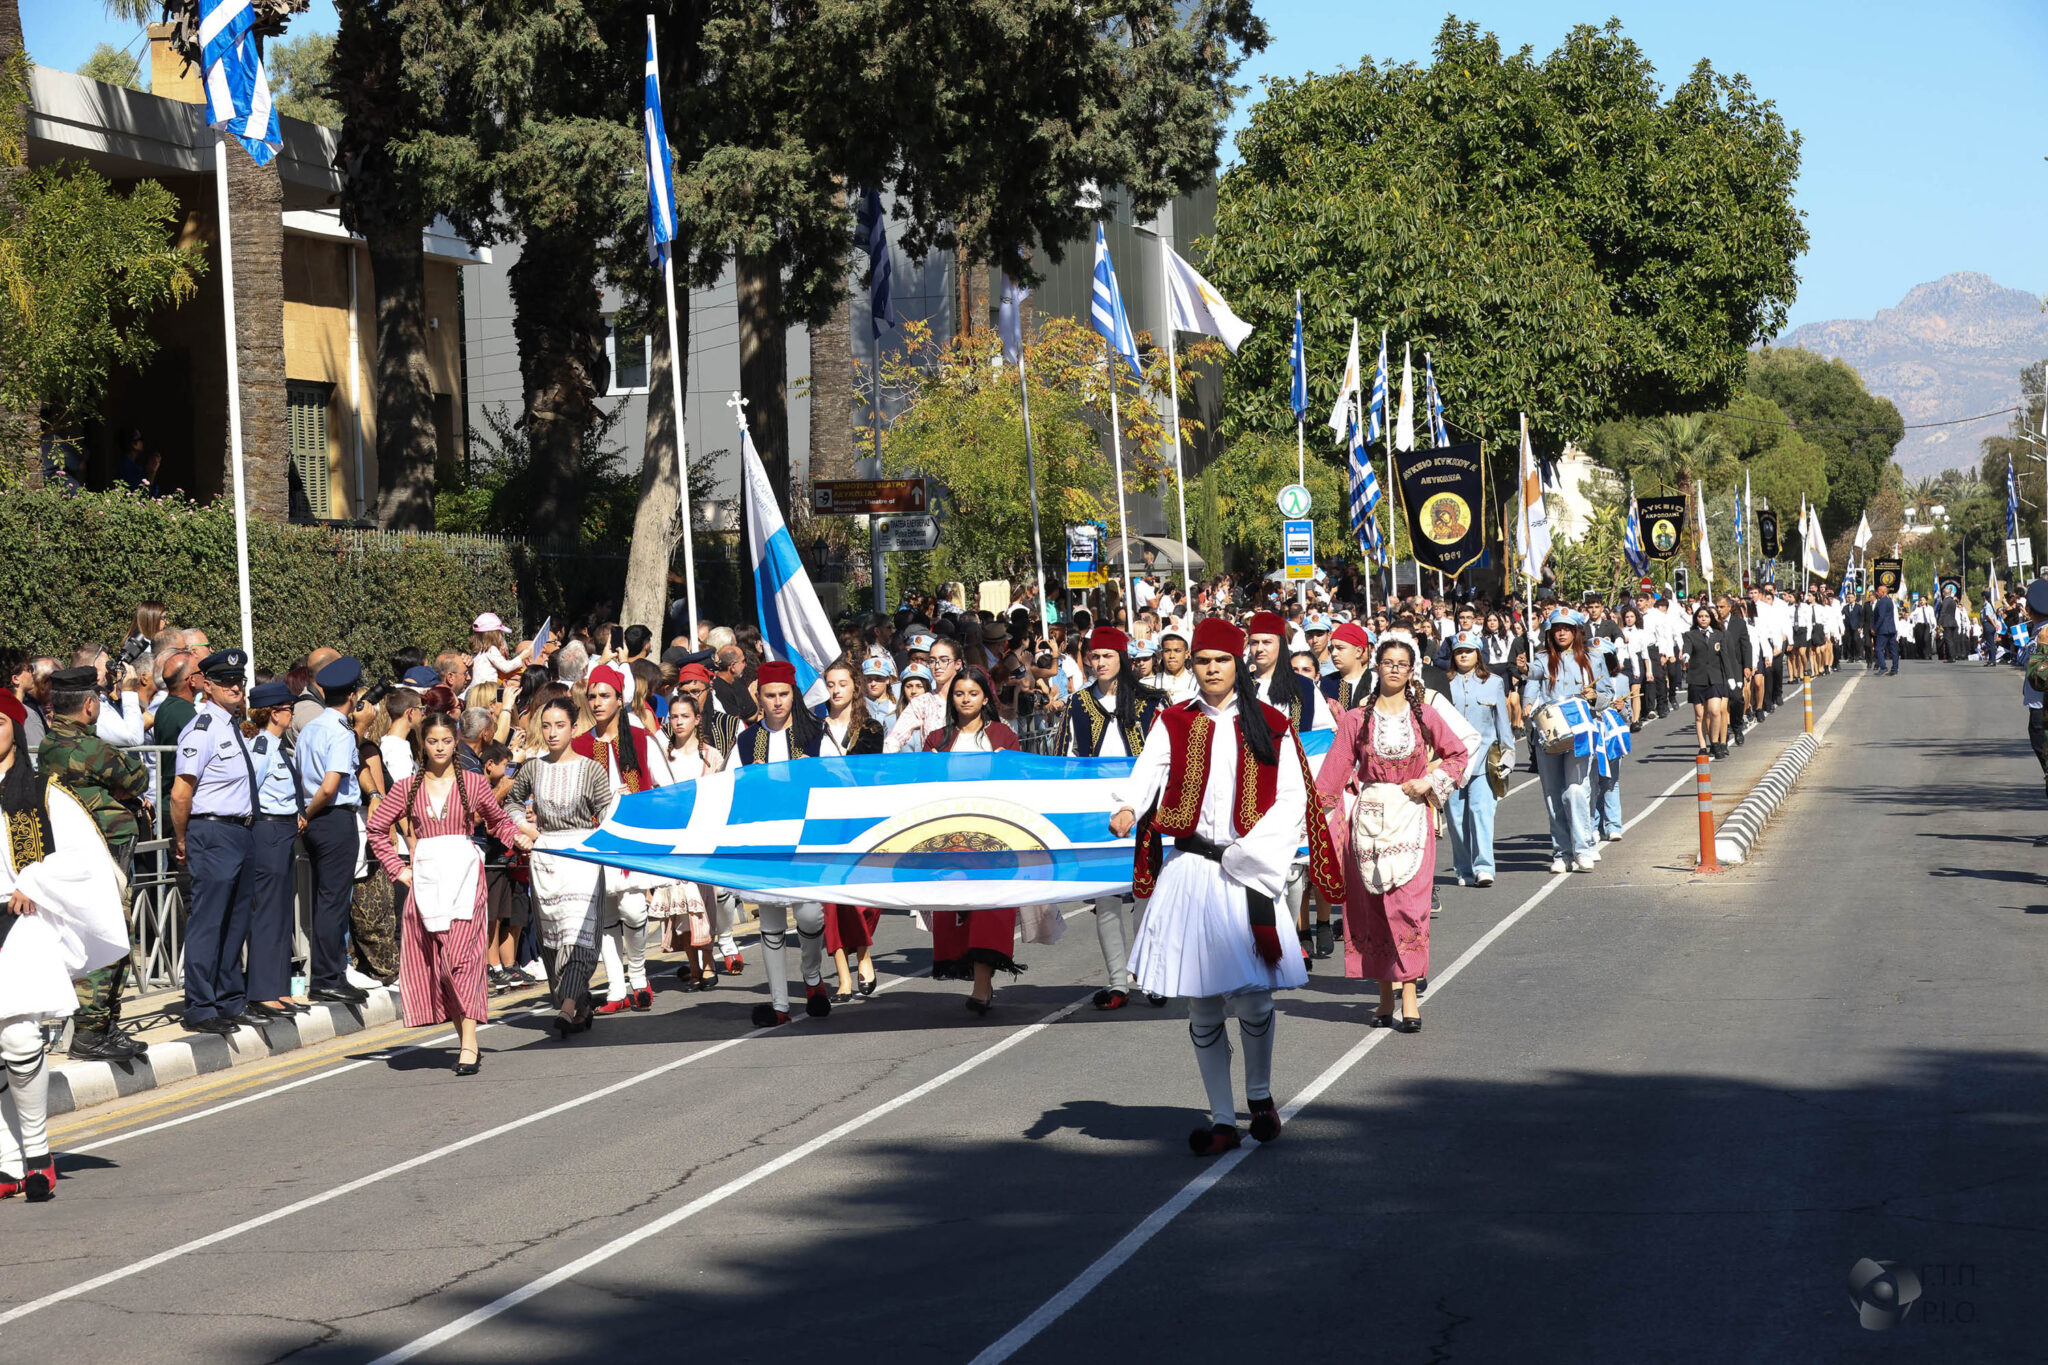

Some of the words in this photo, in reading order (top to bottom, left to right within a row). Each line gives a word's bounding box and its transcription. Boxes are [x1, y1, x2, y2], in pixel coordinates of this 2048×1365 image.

[1403, 459, 1432, 480] ΛΥΚΕΙΟ
[876, 481, 907, 489] ΘΕΑΤΡΟ
[1641, 503, 1684, 515] ΛΥΚΕΙΟ
[1438, 550, 1461, 562] 1961
[875, 803, 947, 839] ΛΥΚΕΙΟ
